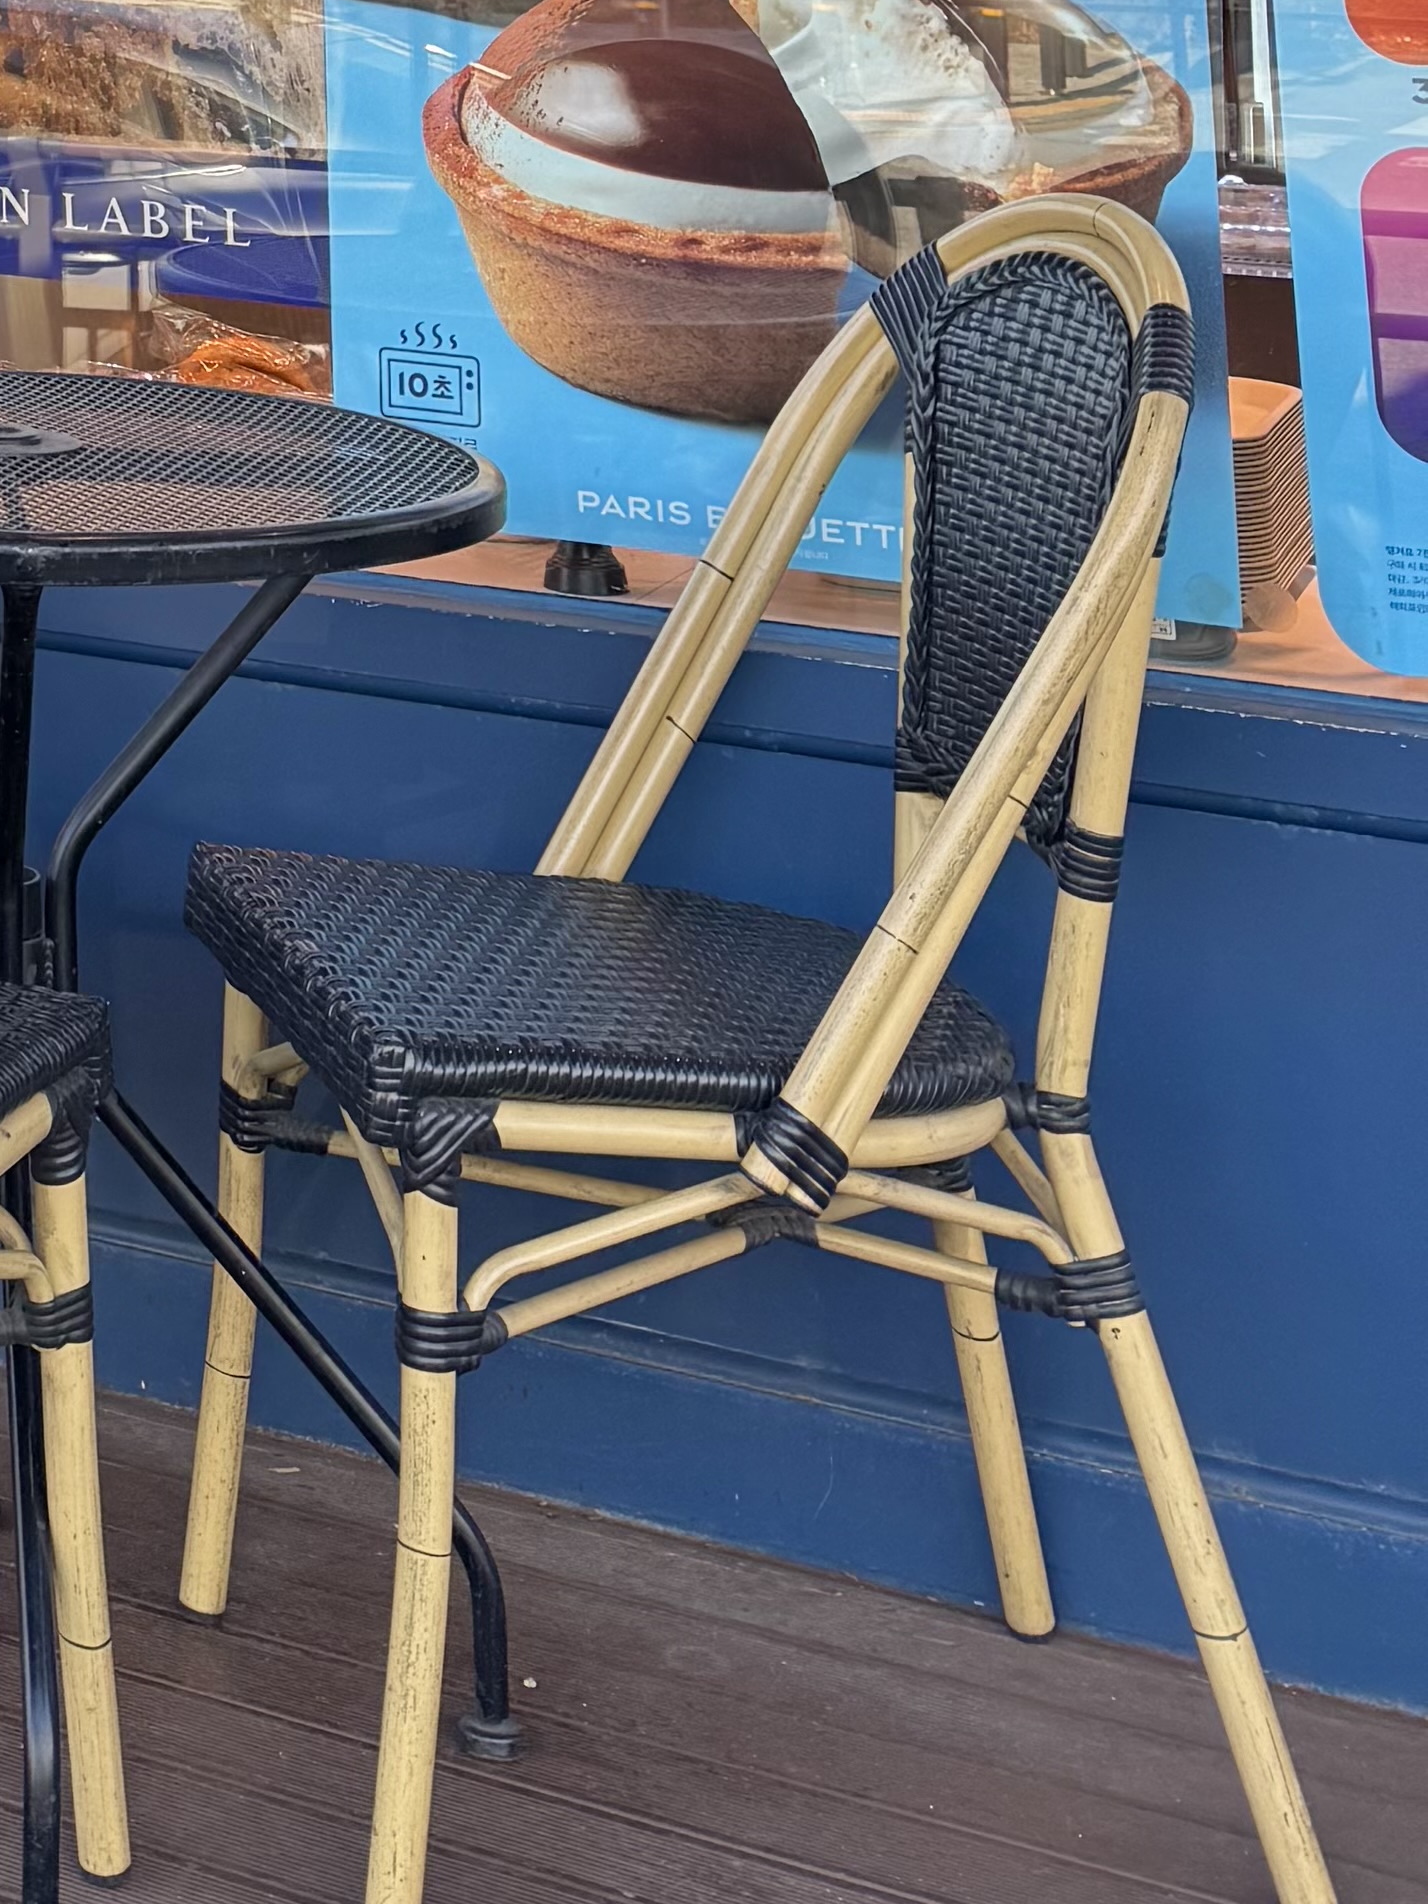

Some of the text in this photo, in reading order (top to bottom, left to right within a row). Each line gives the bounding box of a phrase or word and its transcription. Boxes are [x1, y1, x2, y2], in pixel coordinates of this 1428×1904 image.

[62, 192, 253, 248] LABEL
[398, 371, 455, 400] 10초
[577, 489, 692, 526] PARIS
